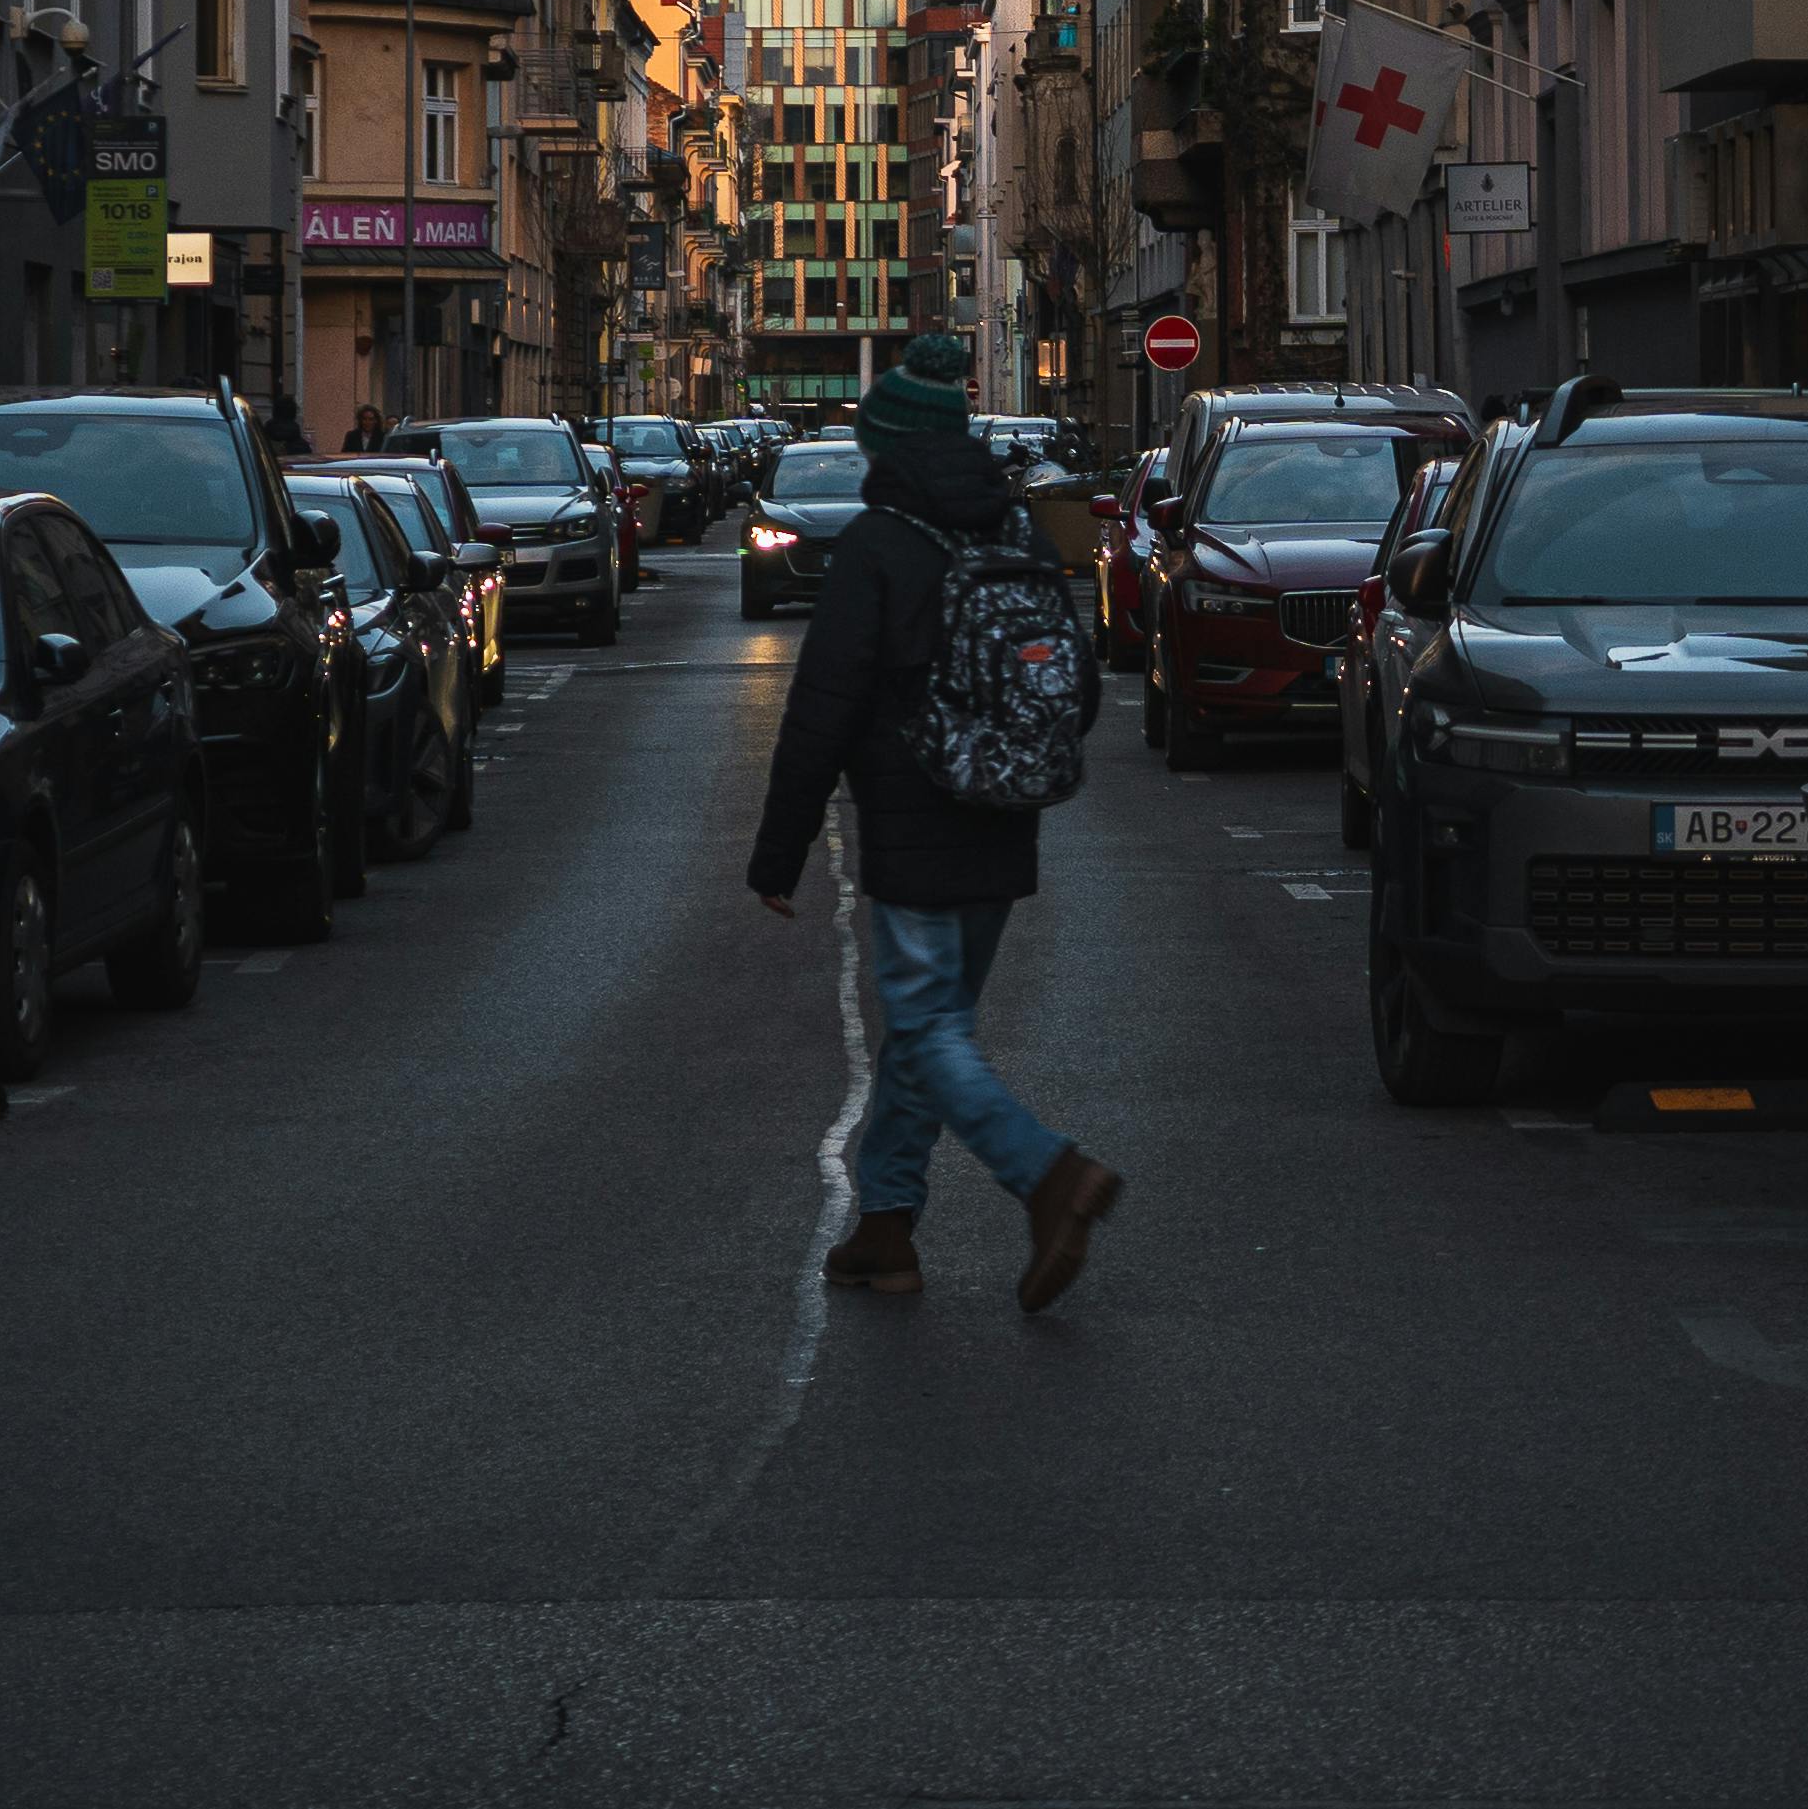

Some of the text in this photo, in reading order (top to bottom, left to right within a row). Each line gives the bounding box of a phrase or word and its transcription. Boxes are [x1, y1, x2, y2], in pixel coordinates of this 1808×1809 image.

[95, 152, 157, 171] SMO
[100, 203, 152, 220] 1018
[1454, 199, 1522, 212] ARTELIER
[426, 222, 477, 243] MARA
[1685, 811, 1733, 844] AB
[1655, 832, 1673, 844] SK
